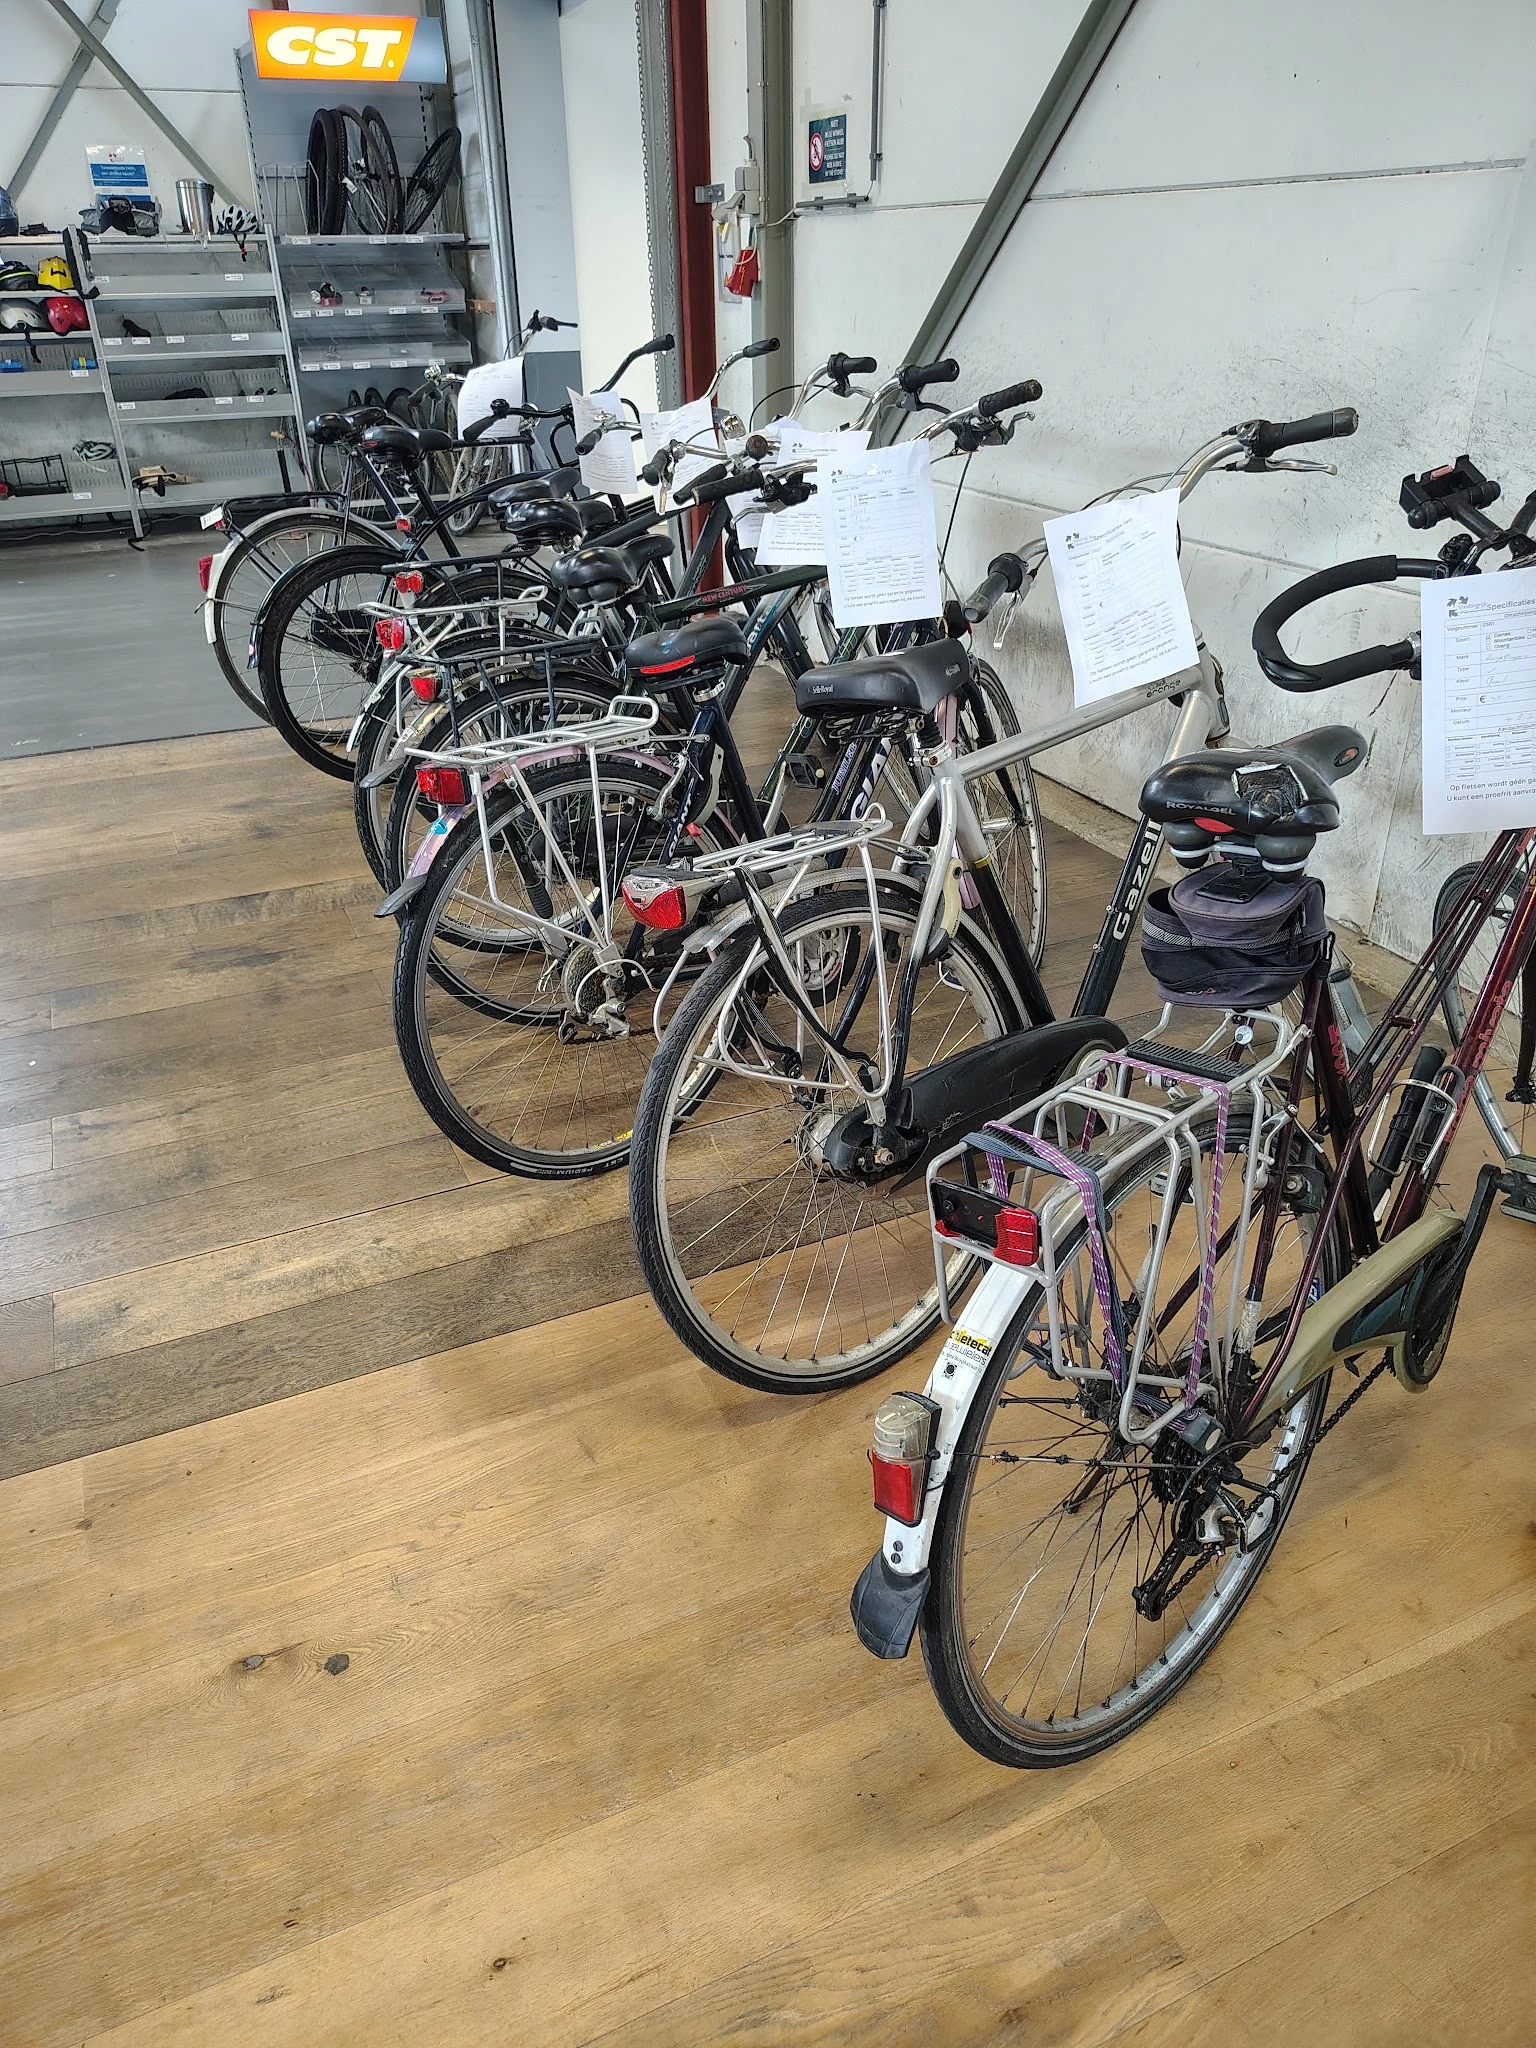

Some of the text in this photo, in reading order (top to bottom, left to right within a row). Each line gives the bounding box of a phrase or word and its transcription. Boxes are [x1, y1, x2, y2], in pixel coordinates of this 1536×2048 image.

[702, 585, 747, 603] NEW CENTURY
[1487, 599, 1536, 611] Specificaties
[746, 605, 773, 657] arta
[1447, 624, 1479, 632] Volgnummer
[1479, 695, 1486, 703] €
[1461, 782, 1485, 790] fietsen
[1487, 780, 1508, 788] wordt
[1485, 790, 1511, 799] proefrit
[1112, 817, 1162, 940] Gazell
